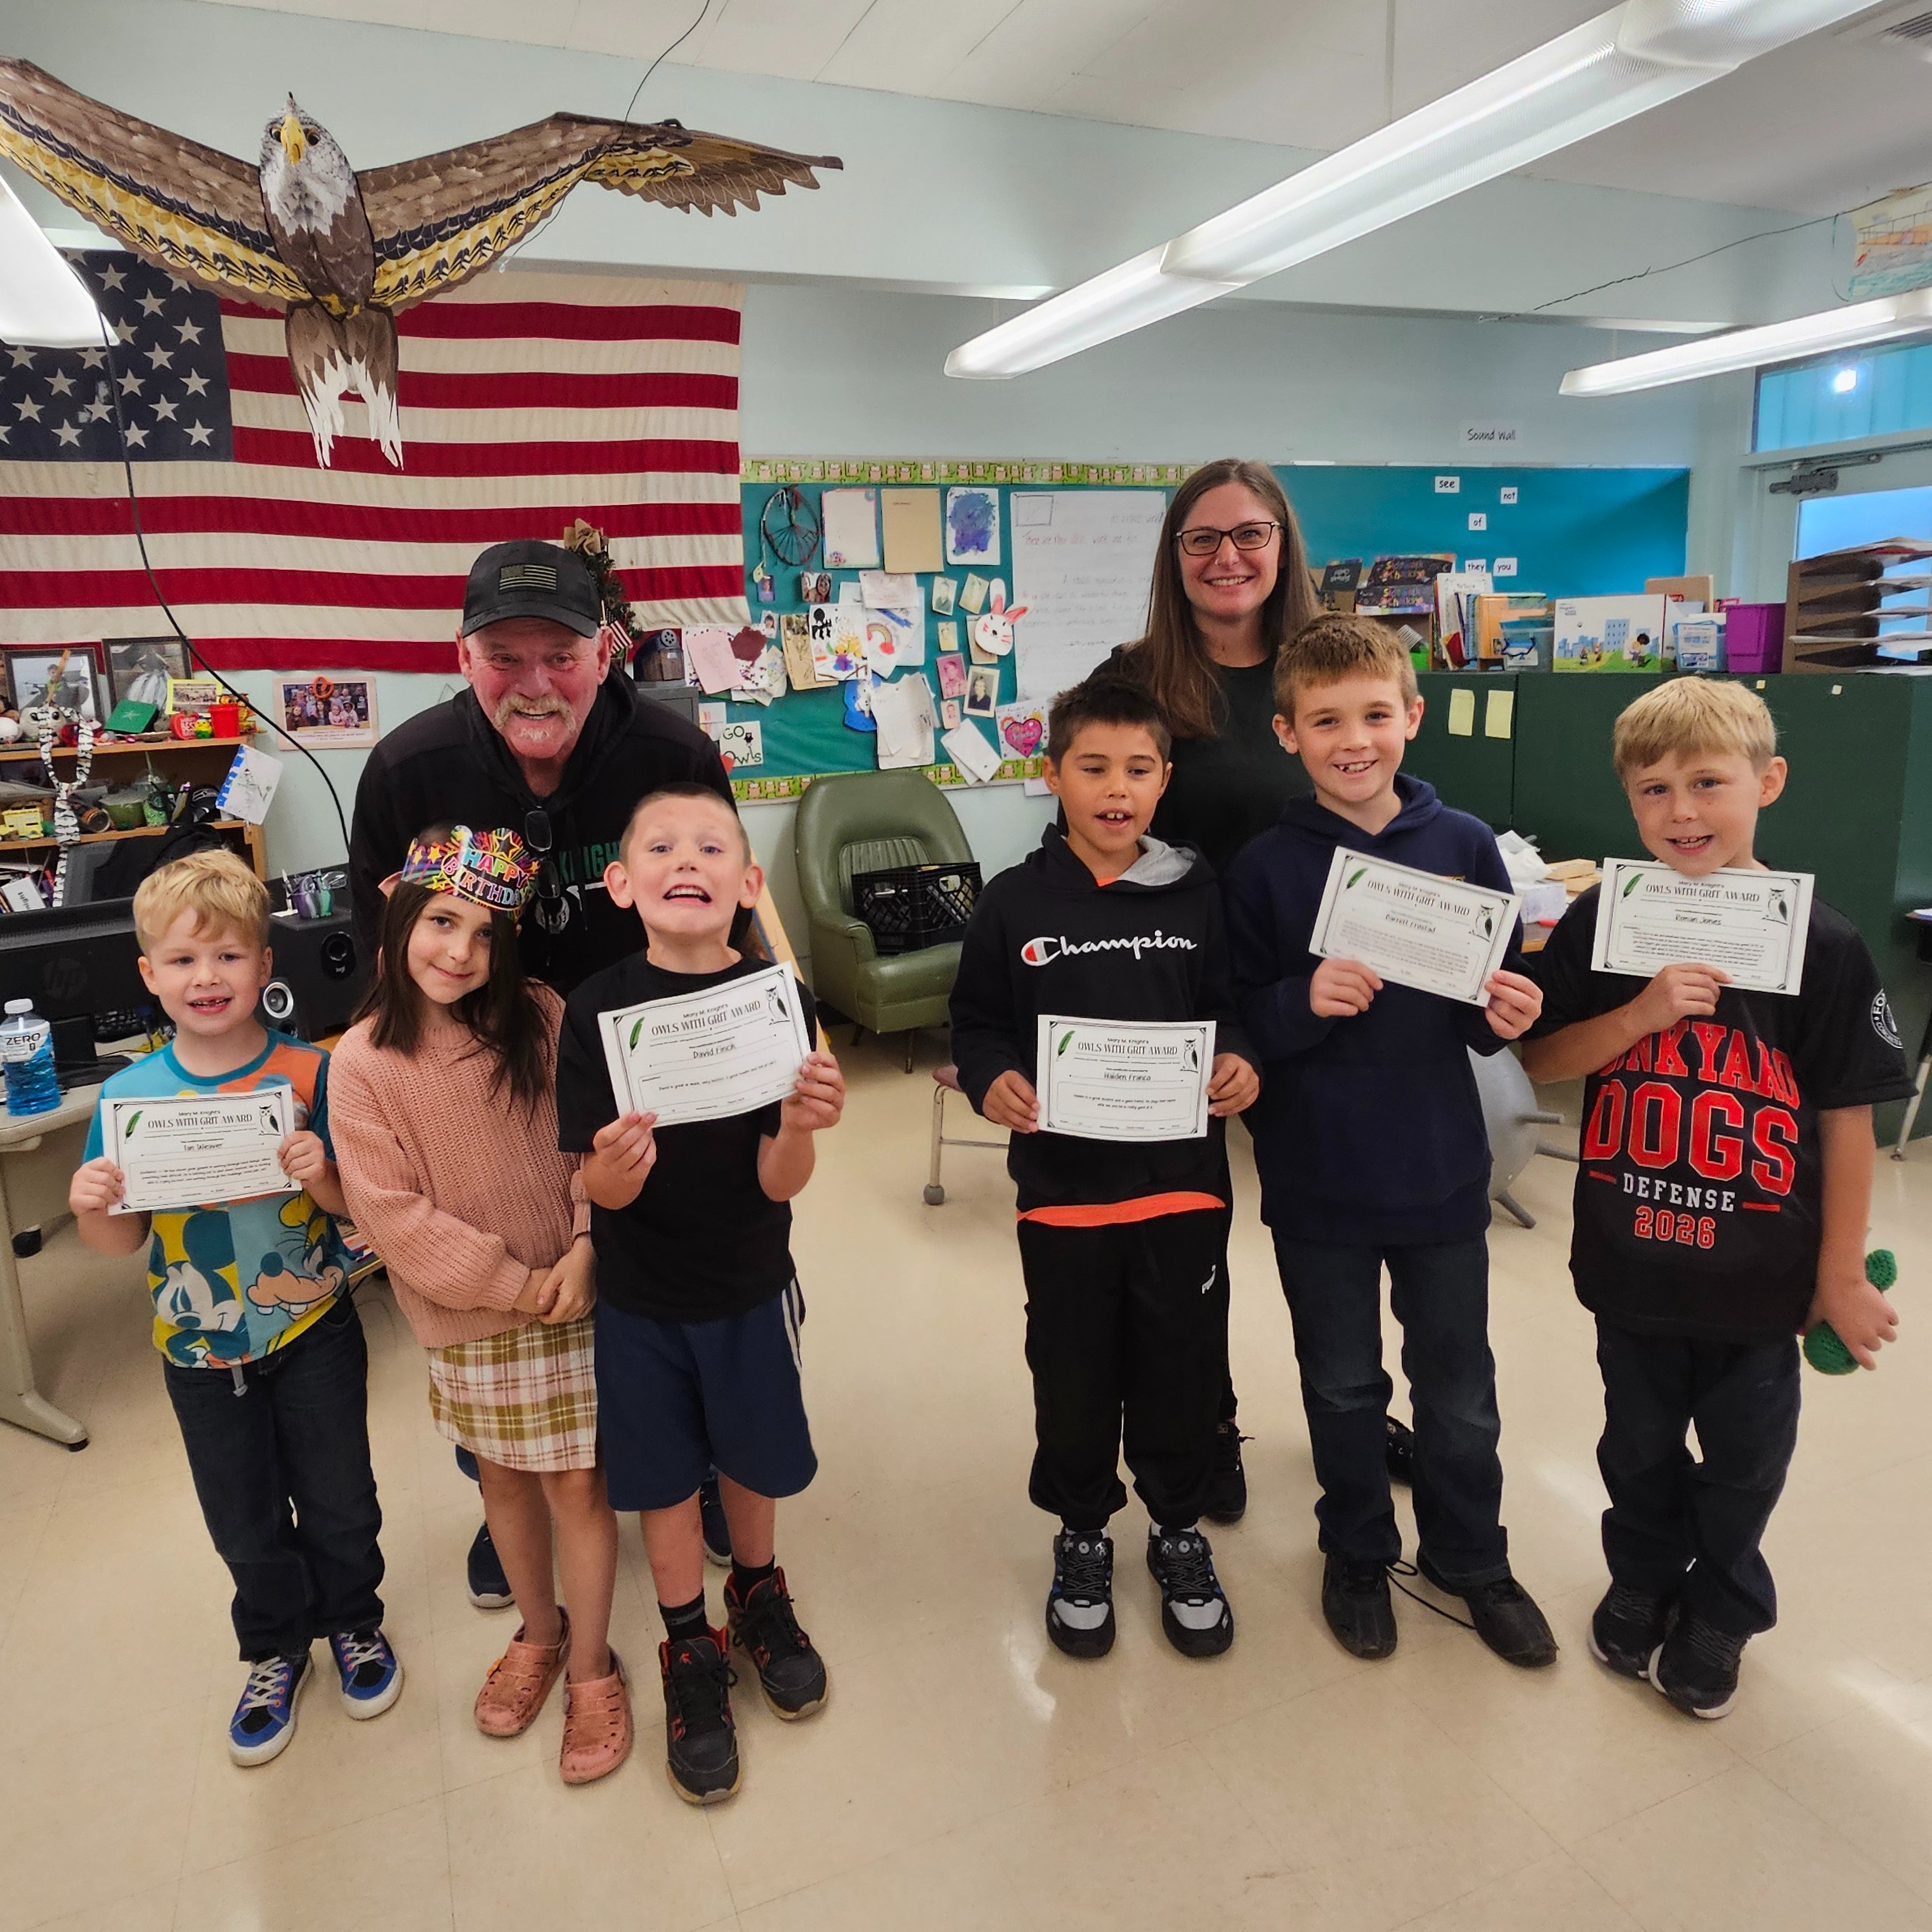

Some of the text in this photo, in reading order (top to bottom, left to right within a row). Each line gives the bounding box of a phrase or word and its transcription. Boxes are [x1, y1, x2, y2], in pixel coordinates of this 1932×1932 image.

[1467, 429, 1495, 441] Sound
[1439, 479, 1455, 488] see
[1503, 492, 1515, 500] not
[1473, 517, 1482, 526] of
[1468, 562, 1485, 572] they
[1497, 563, 1511, 573] you
[723, 726, 745, 740] GO
[463, 849, 530, 889] HAPPY
[443, 856, 535, 906] BIRTHDAY
[1367, 880, 1390, 894] OWLS
[1393, 888, 1414, 901] WITH
[1416, 895, 1435, 906] GRIT
[1439, 901, 1470, 915] AWARD
[1646, 884, 1760, 902] OWLS WITH GRIT AWARD
[1699, 917, 1722, 925] Jones
[1021, 929, 1197, 967] Champion
[651, 1022, 679, 1036] OWLS
[680, 1017, 705, 1031] WITH
[707, 1011, 728, 1025] GRIT
[731, 1000, 761, 1018] AWARD
[5, 1033, 41, 1045] ZERO
[693, 1047, 714, 1059] David
[1078, 1042, 1177, 1055] OWLS WITH GRIT AWARD
[148, 1114, 253, 1128] OWLS WITH GRIT AWARD
[1583, 1078, 1799, 1196] DOGS
[1623, 1173, 1735, 1213] DEFENSE
[1634, 1206, 1716, 1250] 2026
